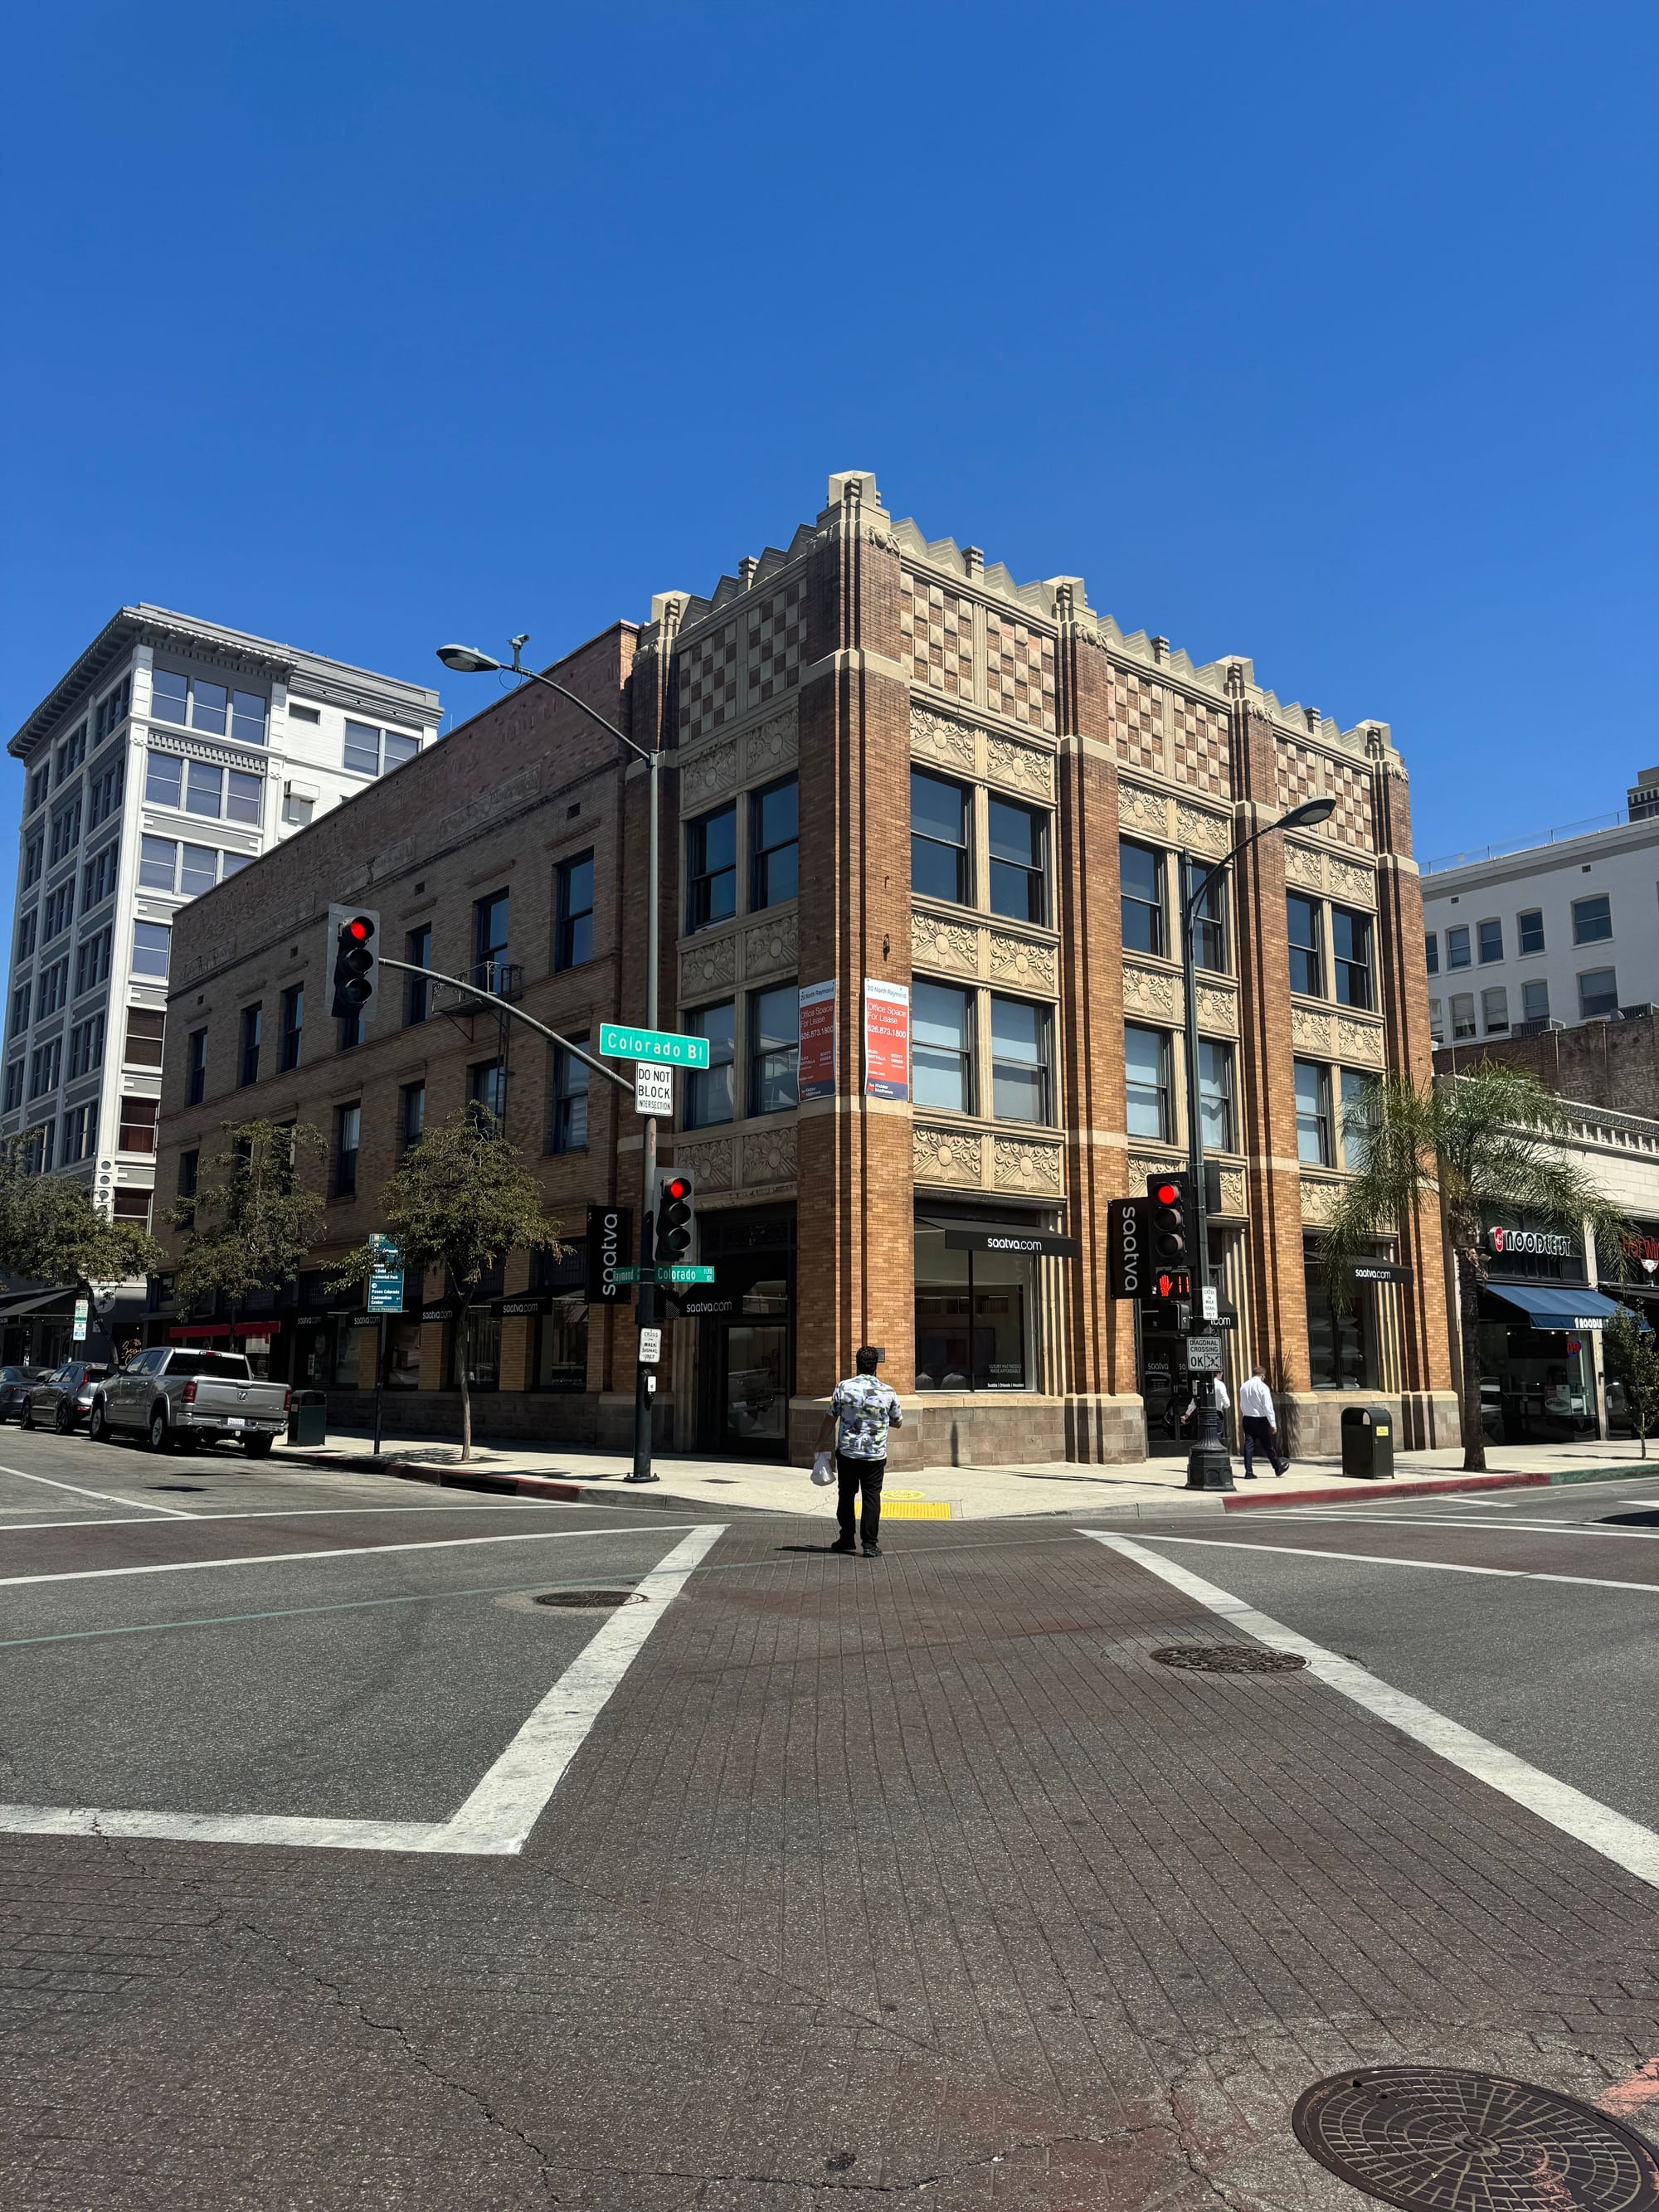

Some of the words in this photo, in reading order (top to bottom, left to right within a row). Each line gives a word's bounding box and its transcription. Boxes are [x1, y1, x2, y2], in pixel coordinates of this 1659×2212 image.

[815, 987, 834, 996] Raymond
[888, 989, 907, 999] Raymond
[815, 1005, 834, 1015] Space
[868, 1002, 886, 1014] Office
[887, 1006, 907, 1017] Space
[810, 1016, 825, 1026] Lease
[868, 1011, 878, 1020] For
[879, 1013, 898, 1024] Lease
[607, 1032, 681, 1058] Colorado
[639, 1068, 651, 1081] DO
[653, 1070, 670, 1083] NOT
[638, 1085, 670, 1100] BLOCK
[638, 1100, 671, 1111] INTERSECTION
[987, 1237, 1042, 1252] saatva.com
[1122, 1206, 1140, 1291] saatva
[601, 1213, 618, 1296] saatva
[613, 1269, 634, 1284] Raymond
[657, 1267, 696, 1281] Colorado
[1355, 1268, 1391, 1280] saatva.com
[1179, 1276, 1190, 1294] 11
[503, 1302, 538, 1314] saatva.com
[686, 1300, 732, 1313] saatva.com
[422, 1309, 453, 1321] saatva.com
[1147, 1362, 1169, 1370] saatva
[1190, 1356, 1204, 1368] OK
